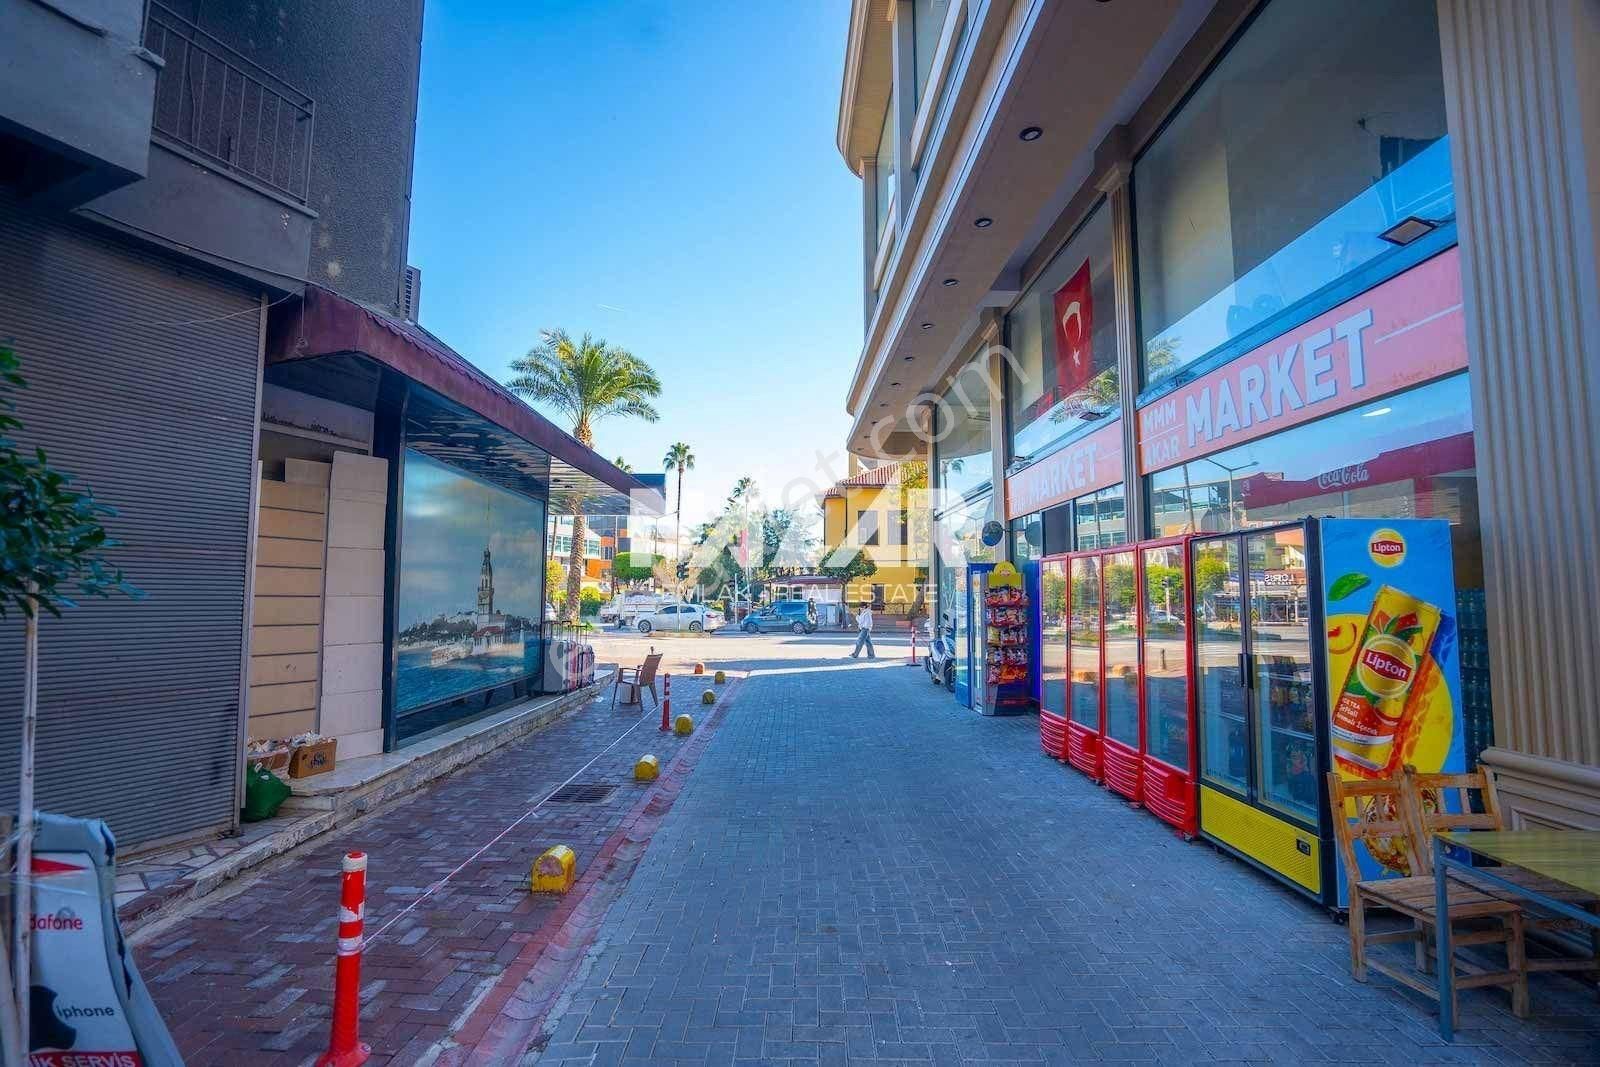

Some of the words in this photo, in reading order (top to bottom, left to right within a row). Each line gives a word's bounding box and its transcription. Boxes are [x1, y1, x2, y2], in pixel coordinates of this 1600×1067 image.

[1185, 308, 1373, 449] MARKET
[1373, 543, 1401, 554] Lipton
[1366, 651, 1408, 679] Lipton
[30, 911, 83, 931] dafone
[61, 1052, 136, 1067] SERVİS
